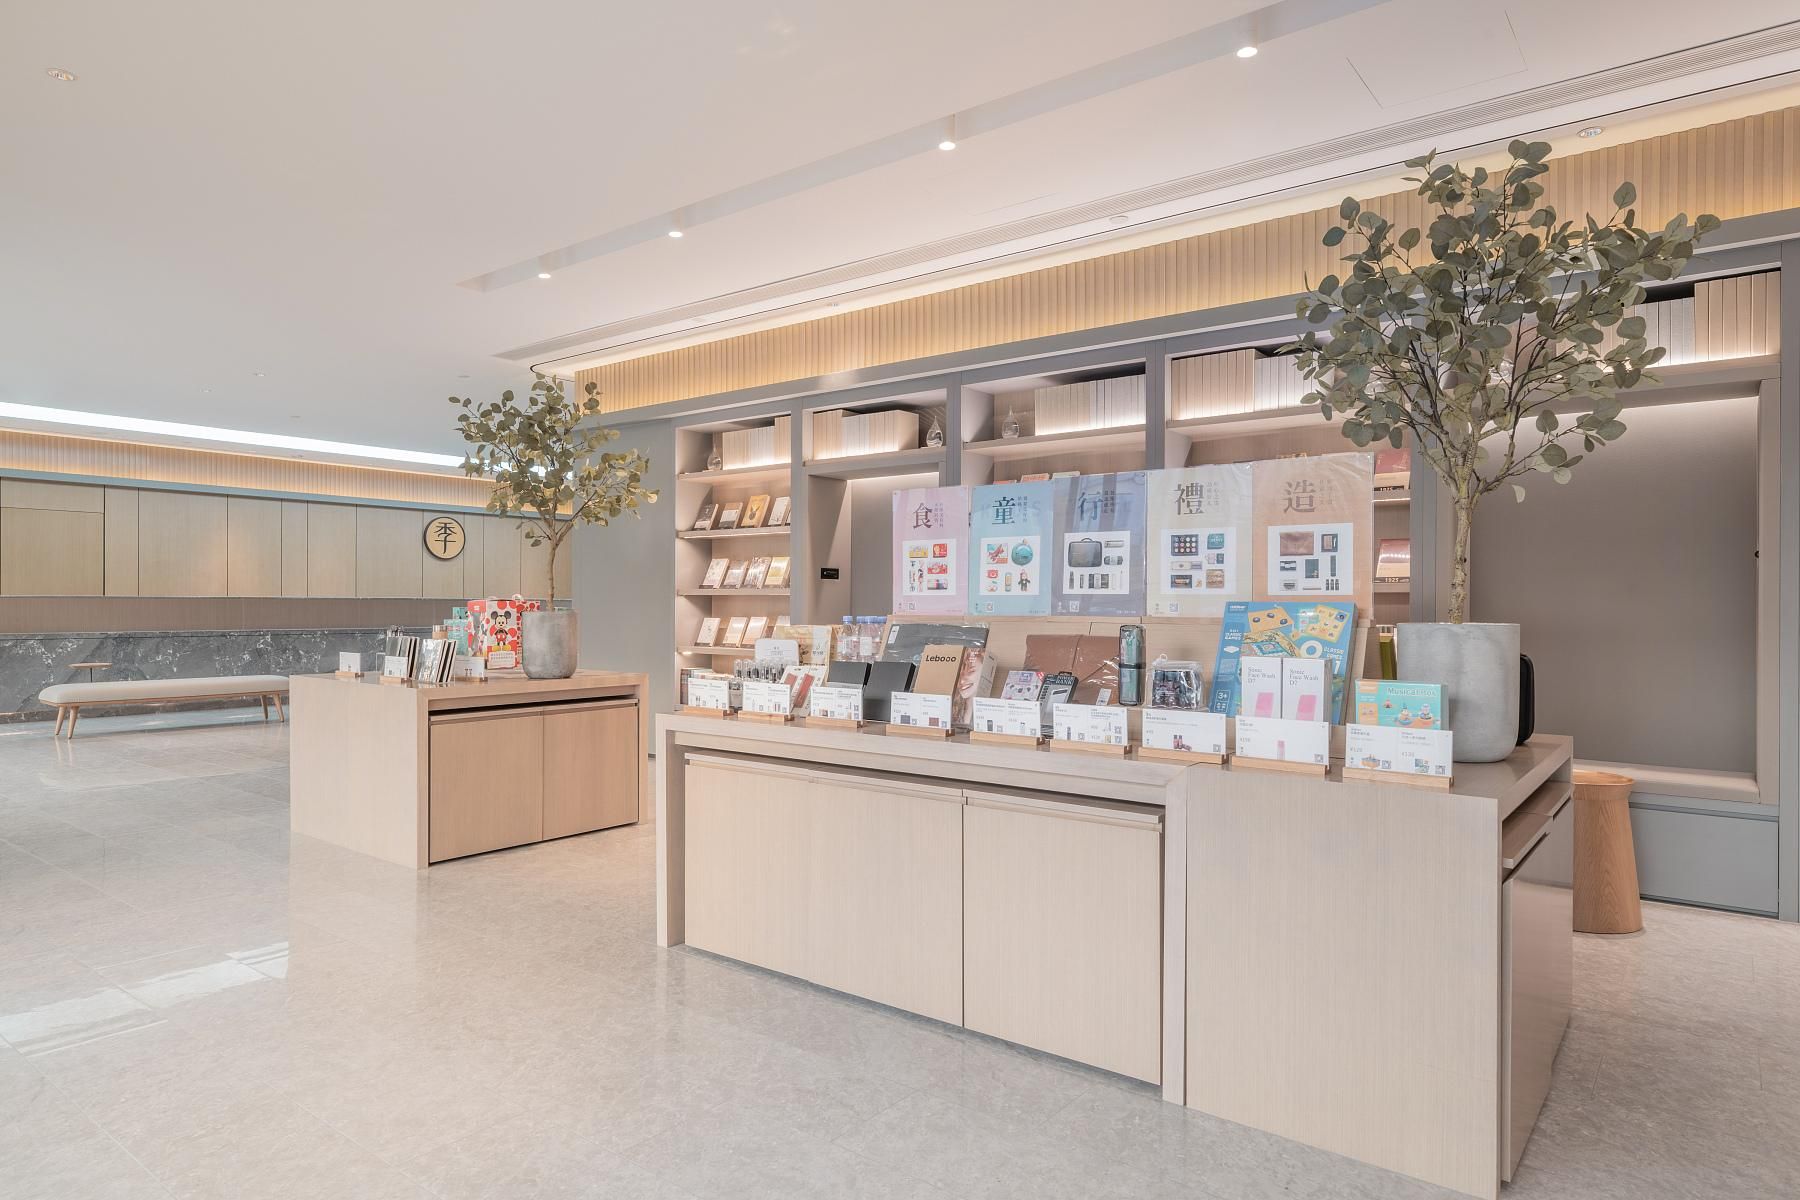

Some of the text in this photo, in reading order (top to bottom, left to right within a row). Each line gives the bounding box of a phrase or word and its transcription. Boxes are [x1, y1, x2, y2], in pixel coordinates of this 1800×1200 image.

[992, 496, 1016, 525] 童
[1078, 491, 1103, 521] 行
[1173, 482, 1205, 515] 禮
[1282, 480, 1316, 514] 造
[912, 502, 933, 529] 食
[433, 522, 458, 554] 季
